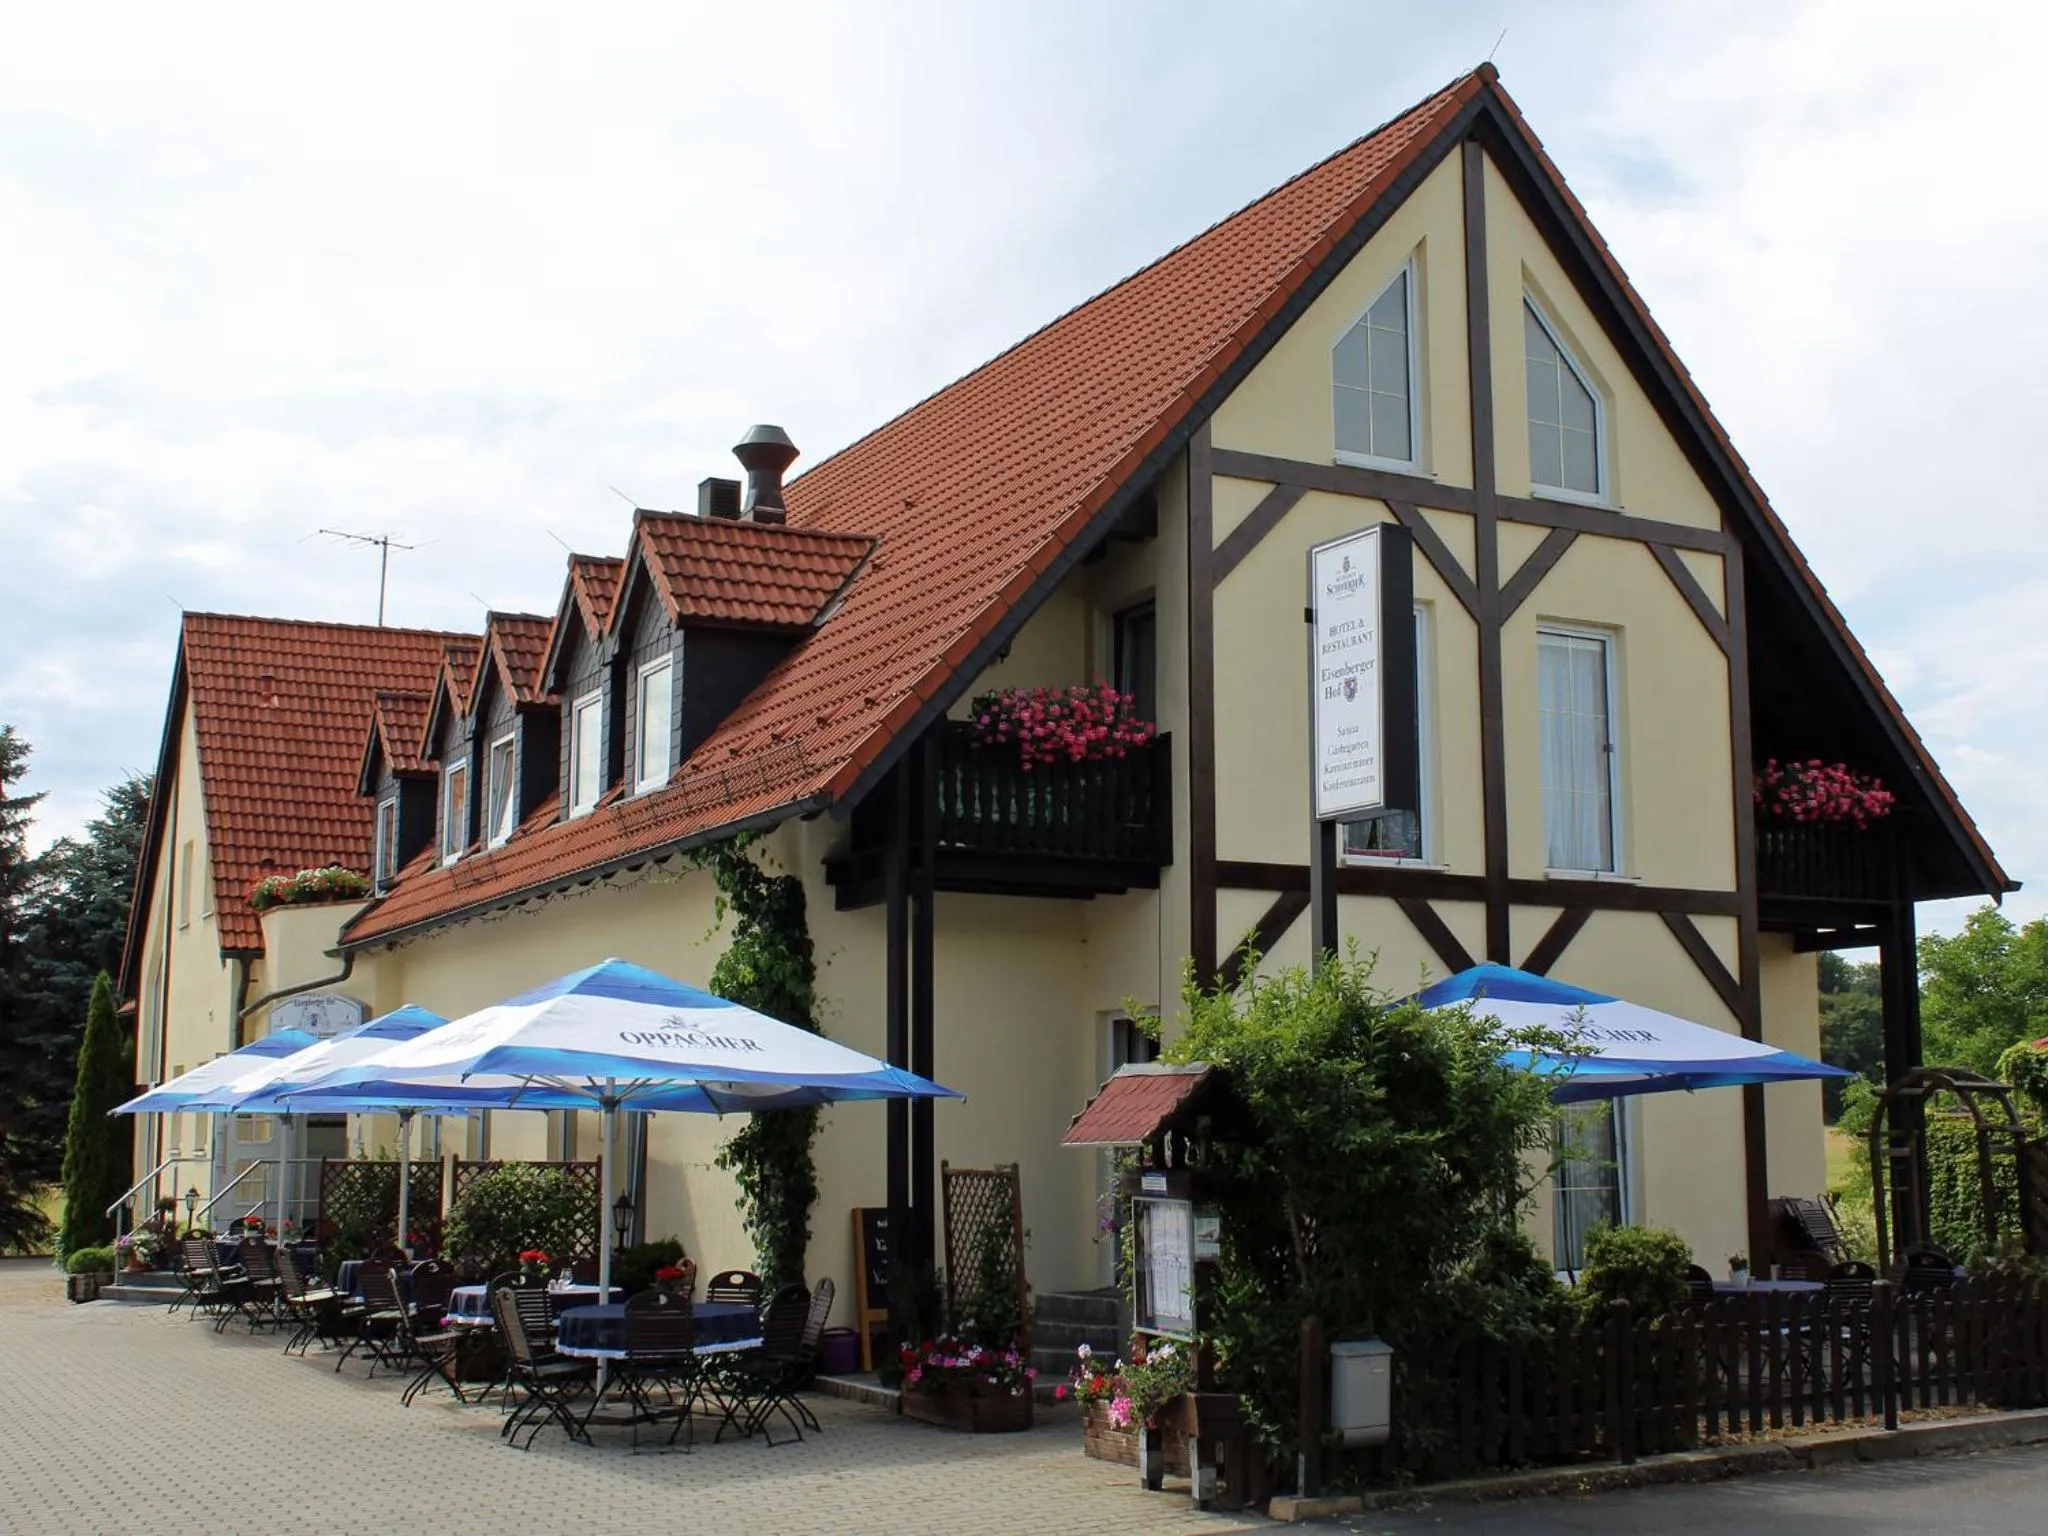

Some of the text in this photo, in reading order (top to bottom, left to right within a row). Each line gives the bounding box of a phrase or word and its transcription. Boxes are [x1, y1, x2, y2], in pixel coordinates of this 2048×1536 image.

[1329, 618, 1365, 637] HOTEL &
[1322, 630, 1374, 655] RESTAURANT
[1321, 659, 1376, 682] Eisenberger
[1325, 682, 1342, 700] Hof
[619, 1031, 764, 1052] OPPACHER
